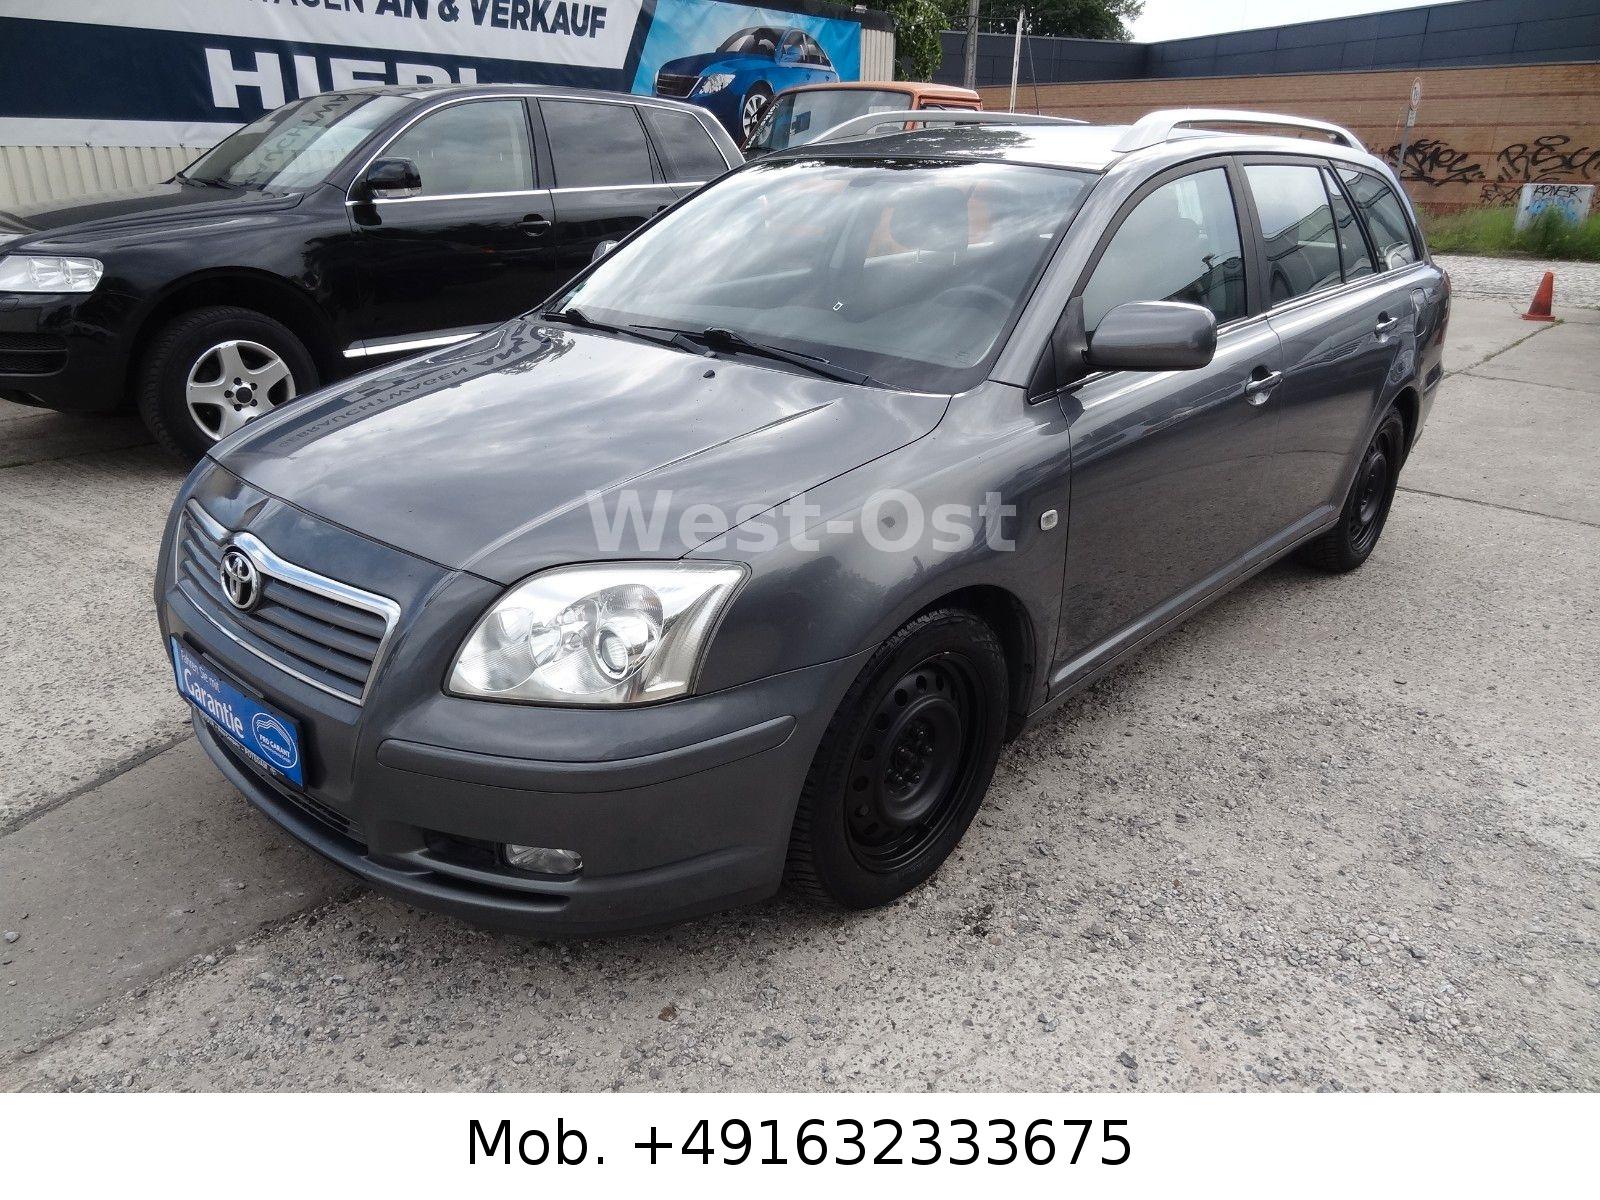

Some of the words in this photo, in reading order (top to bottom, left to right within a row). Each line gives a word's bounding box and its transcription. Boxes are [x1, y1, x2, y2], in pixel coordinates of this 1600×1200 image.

[374, 0, 429, 20] AN
[437, 0, 460, 22] &
[469, 0, 608, 39] VERKAUF
[184, 668, 246, 740] Garantie
